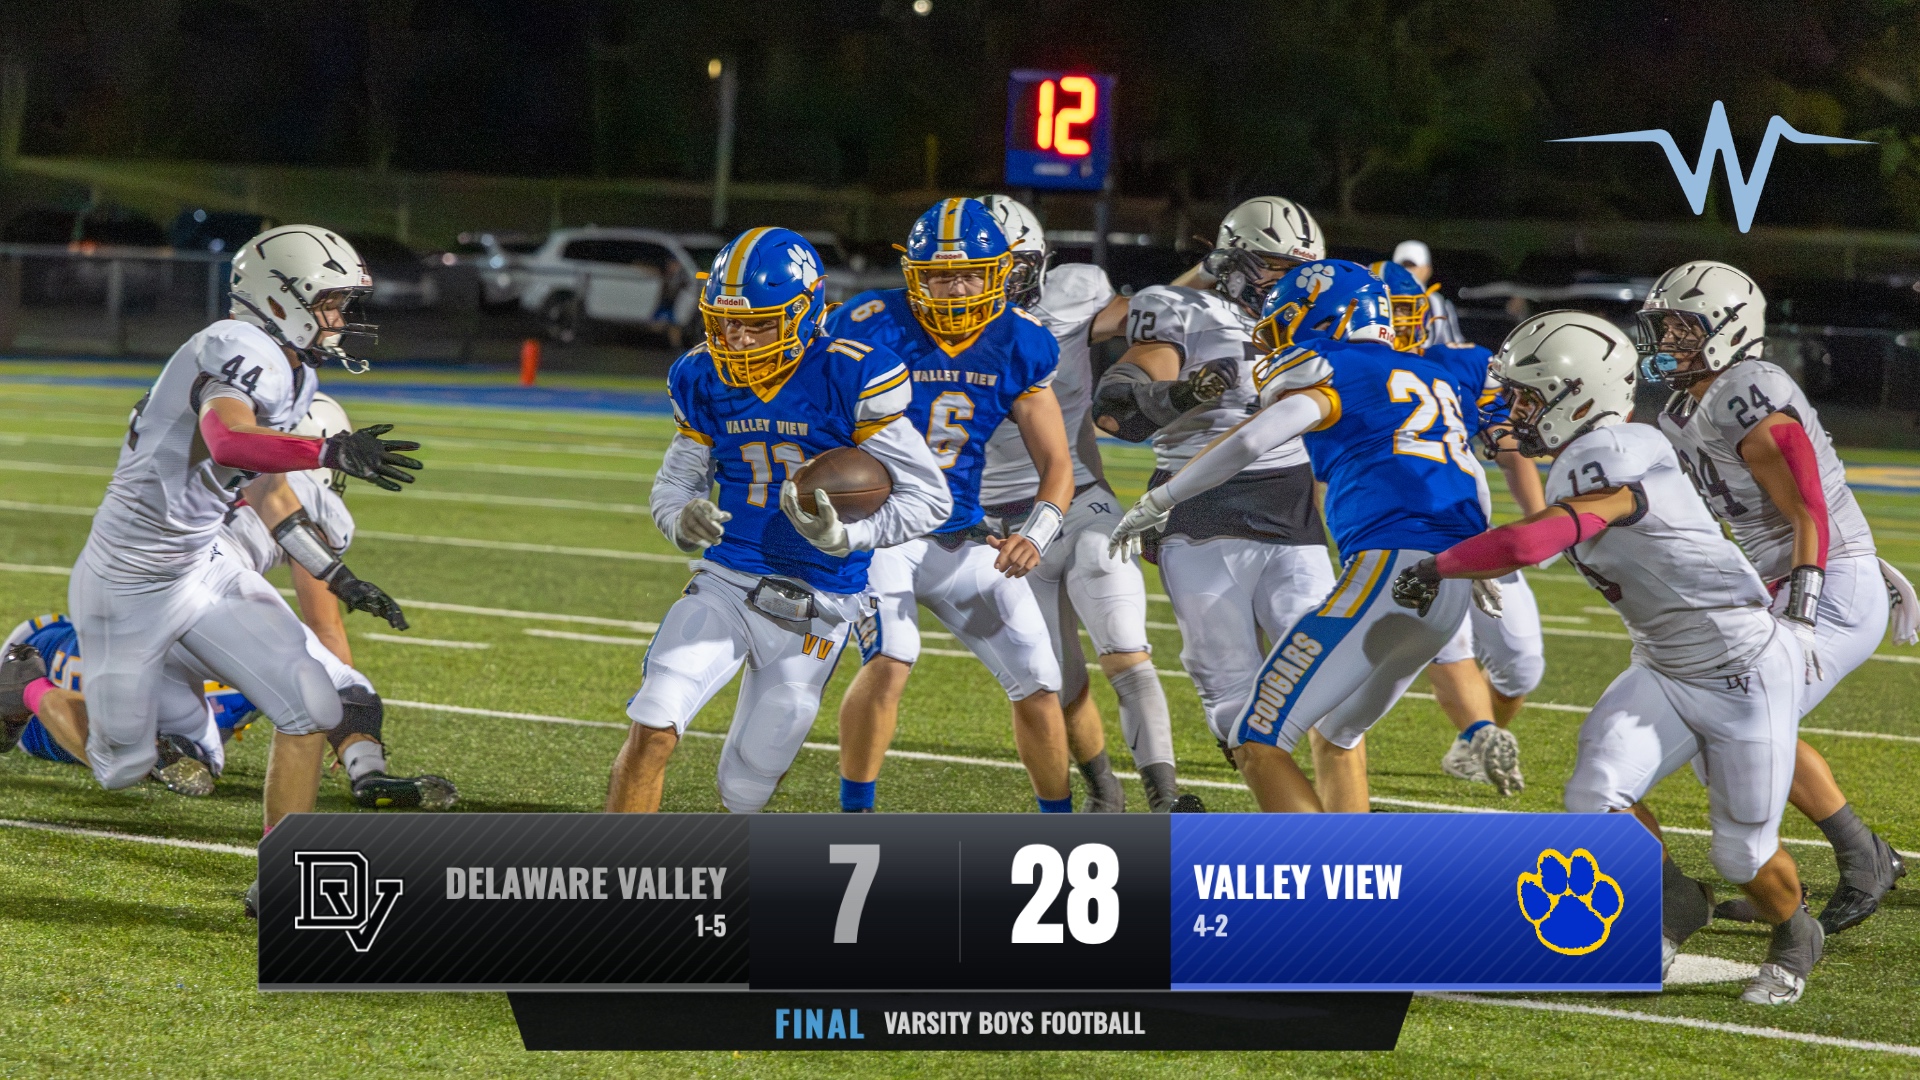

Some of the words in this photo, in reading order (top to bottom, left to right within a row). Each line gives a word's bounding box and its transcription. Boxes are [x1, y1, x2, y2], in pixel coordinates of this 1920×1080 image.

[1037, 76, 1096, 156] 12
[716, 297, 744, 306] Riddell
[851, 299, 886, 323] 6
[1130, 308, 1156, 341] 72
[826, 338, 874, 362] 11
[221, 354, 264, 396] 44
[912, 370, 960, 383] VALLEY
[965, 371, 998, 387] VIEW
[1727, 383, 1777, 429] 24
[726, 418, 770, 434] VALLEY
[776, 420, 809, 436] VIEW
[926, 391, 975, 469] 6
[1567, 460, 1610, 497] 13
[802, 632, 835, 660] VV
[1247, 632, 1323, 735] COUGARS
[1726, 675, 1751, 694] DV
